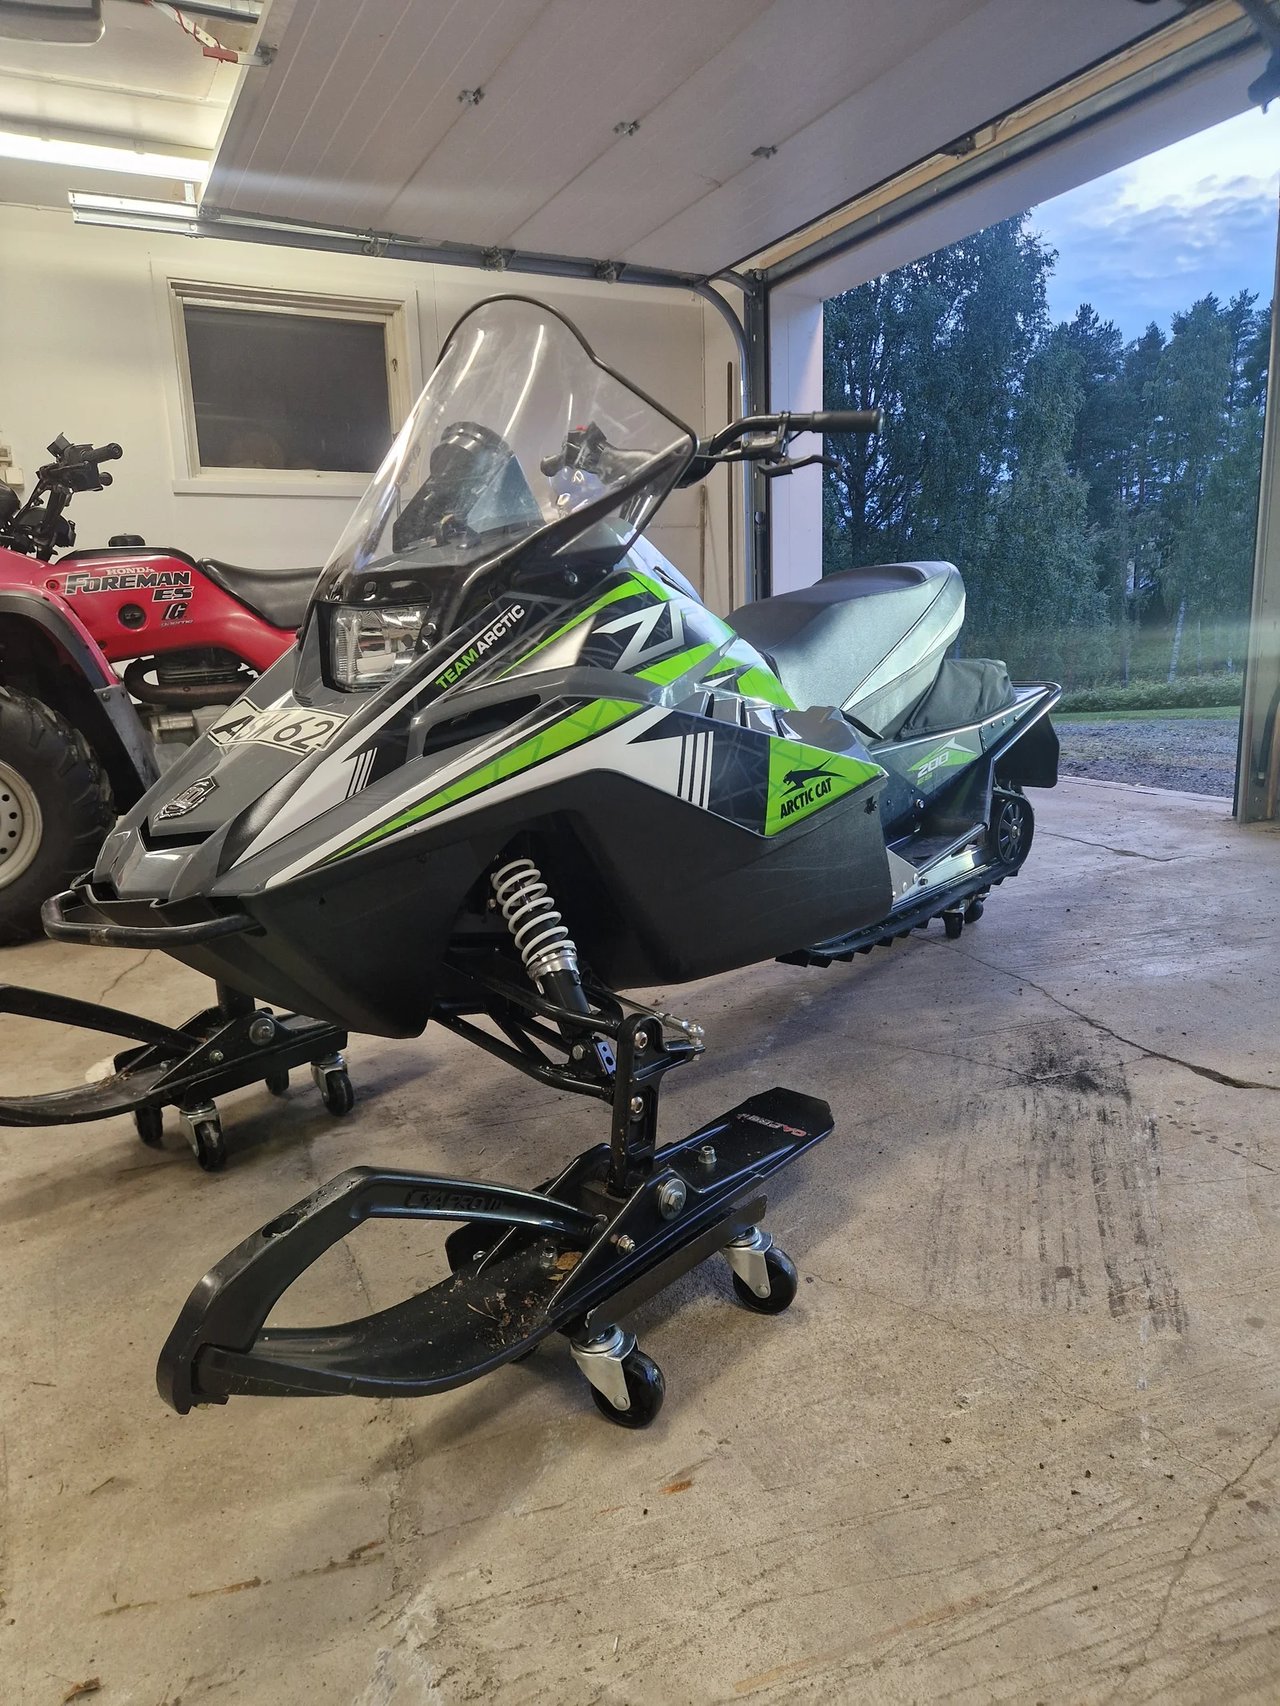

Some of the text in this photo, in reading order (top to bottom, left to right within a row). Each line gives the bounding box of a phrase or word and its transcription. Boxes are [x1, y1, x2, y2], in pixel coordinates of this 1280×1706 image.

[64, 570, 192, 596] FOREMAN
[106, 566, 155, 577] HONDA
[151, 586, 195, 603] ES
[435, 604, 525, 689] TEAM ARCTIC
[917, 750, 950, 778] 200
[780, 776, 832, 820] ARCTIC CAT
